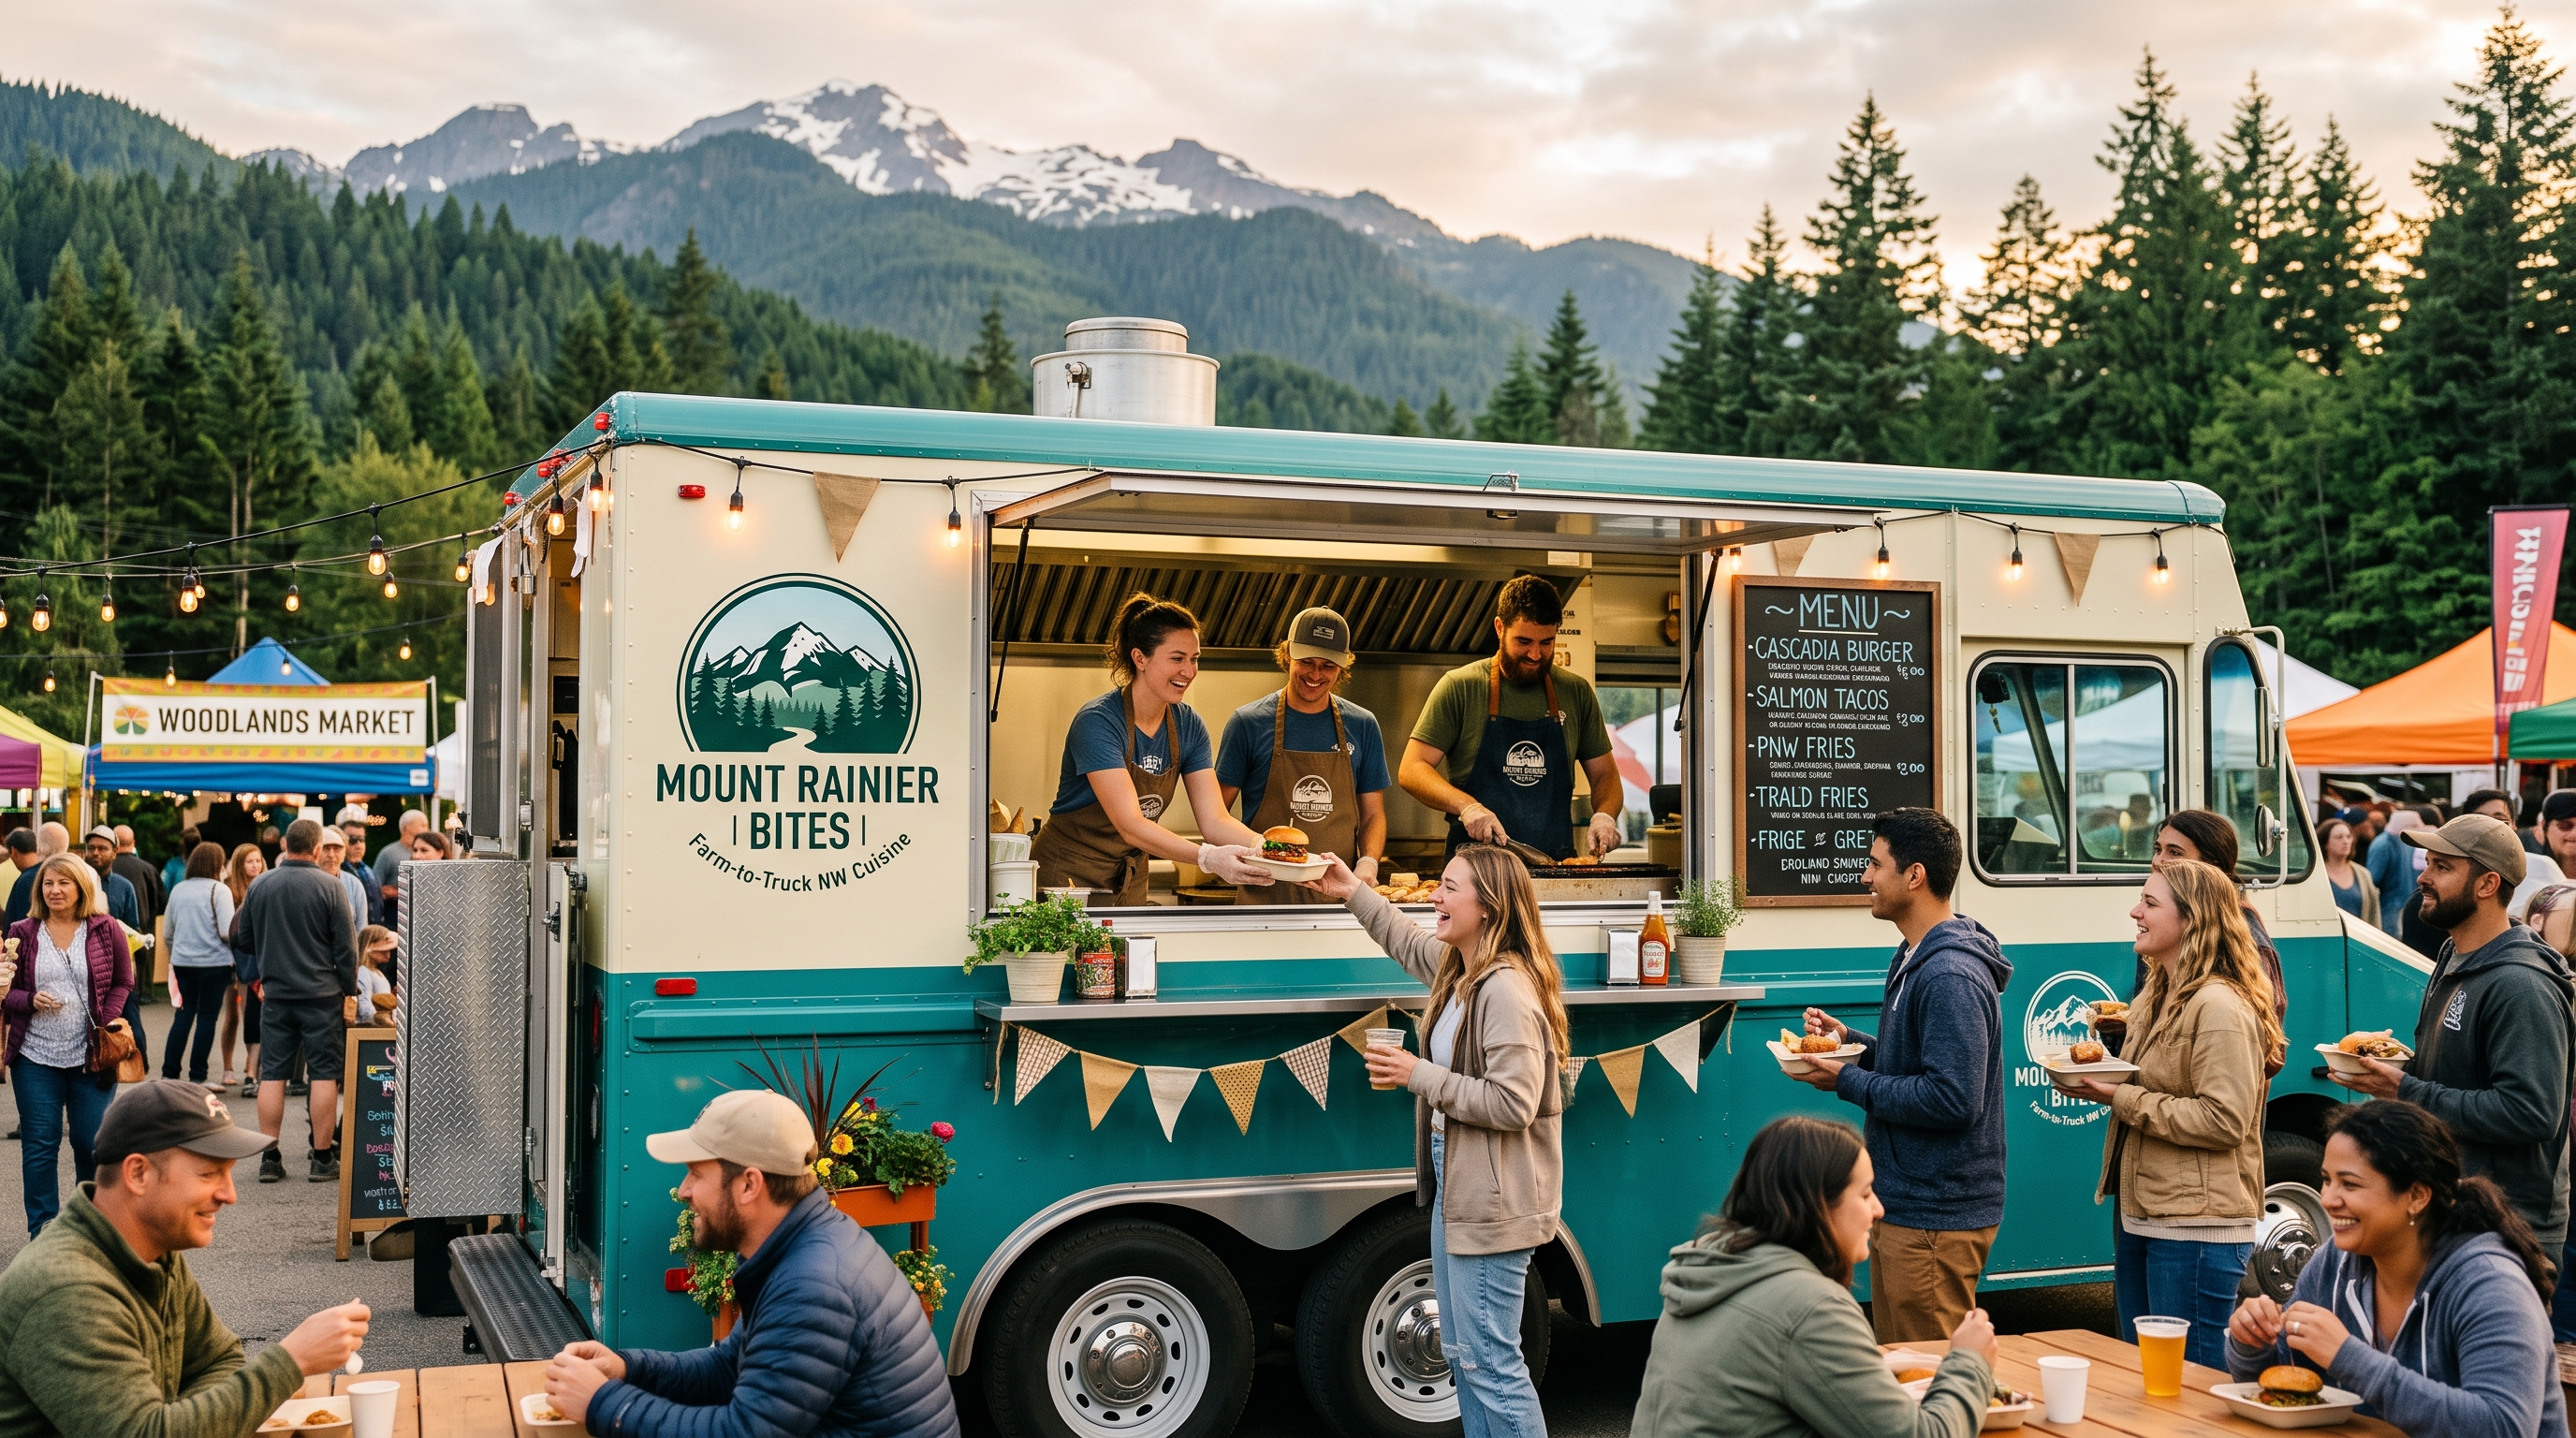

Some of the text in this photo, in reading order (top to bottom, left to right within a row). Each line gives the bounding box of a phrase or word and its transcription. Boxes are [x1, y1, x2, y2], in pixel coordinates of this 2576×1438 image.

[1799, 593, 1879, 630] MENU
[1755, 636, 1914, 663] CASCADIA BURGER
[1756, 684, 1889, 711] SALMON TACOS
[158, 708, 415, 734] WOODLANDS MARKET
[1757, 736, 1856, 759] PNW FRIES
[656, 763, 940, 804] MOUNT RAINIER
[1755, 785, 1869, 809] TRALD FRIES
[750, 811, 850, 850] BITES
[1759, 829, 1806, 850] FRIGE
[688, 832, 912, 892] Farm-to-Truck NW Cuisine
[2014, 1066, 2054, 1087] MOU
